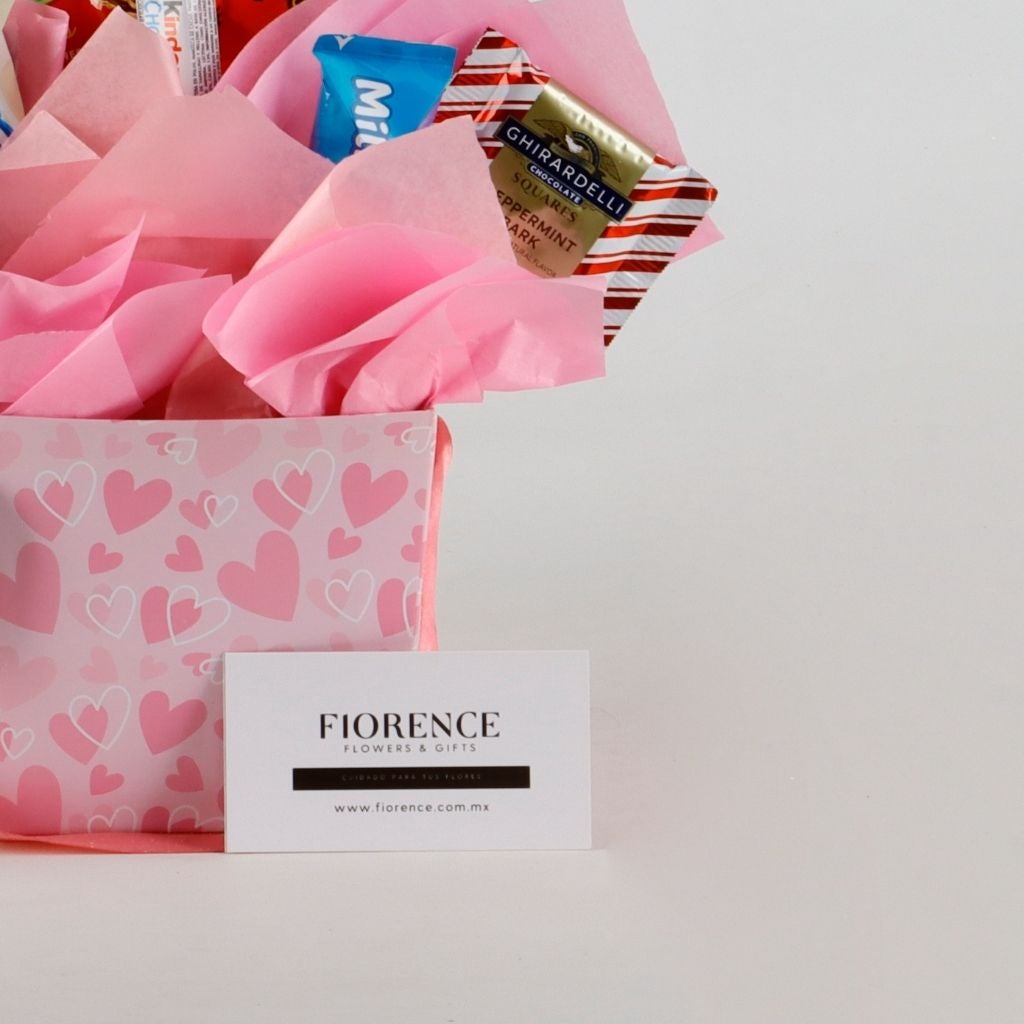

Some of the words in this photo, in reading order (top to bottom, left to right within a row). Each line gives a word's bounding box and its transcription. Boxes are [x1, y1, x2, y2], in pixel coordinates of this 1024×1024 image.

[163, 1, 182, 65] Kind
[506, 126, 625, 216] GHIRARDELLI
[529, 165, 582, 205] CHOCOLATE
[512, 172, 579, 223] SQUARES
[319, 711, 501, 740] FIORENCE
[344, 743, 412, 754] FLOWERS
[419, 743, 428, 753] &
[435, 742, 478, 753] GIFTS
[445, 772, 482, 781] FLORES
[334, 801, 490, 814] www.fiorence.com.mx
